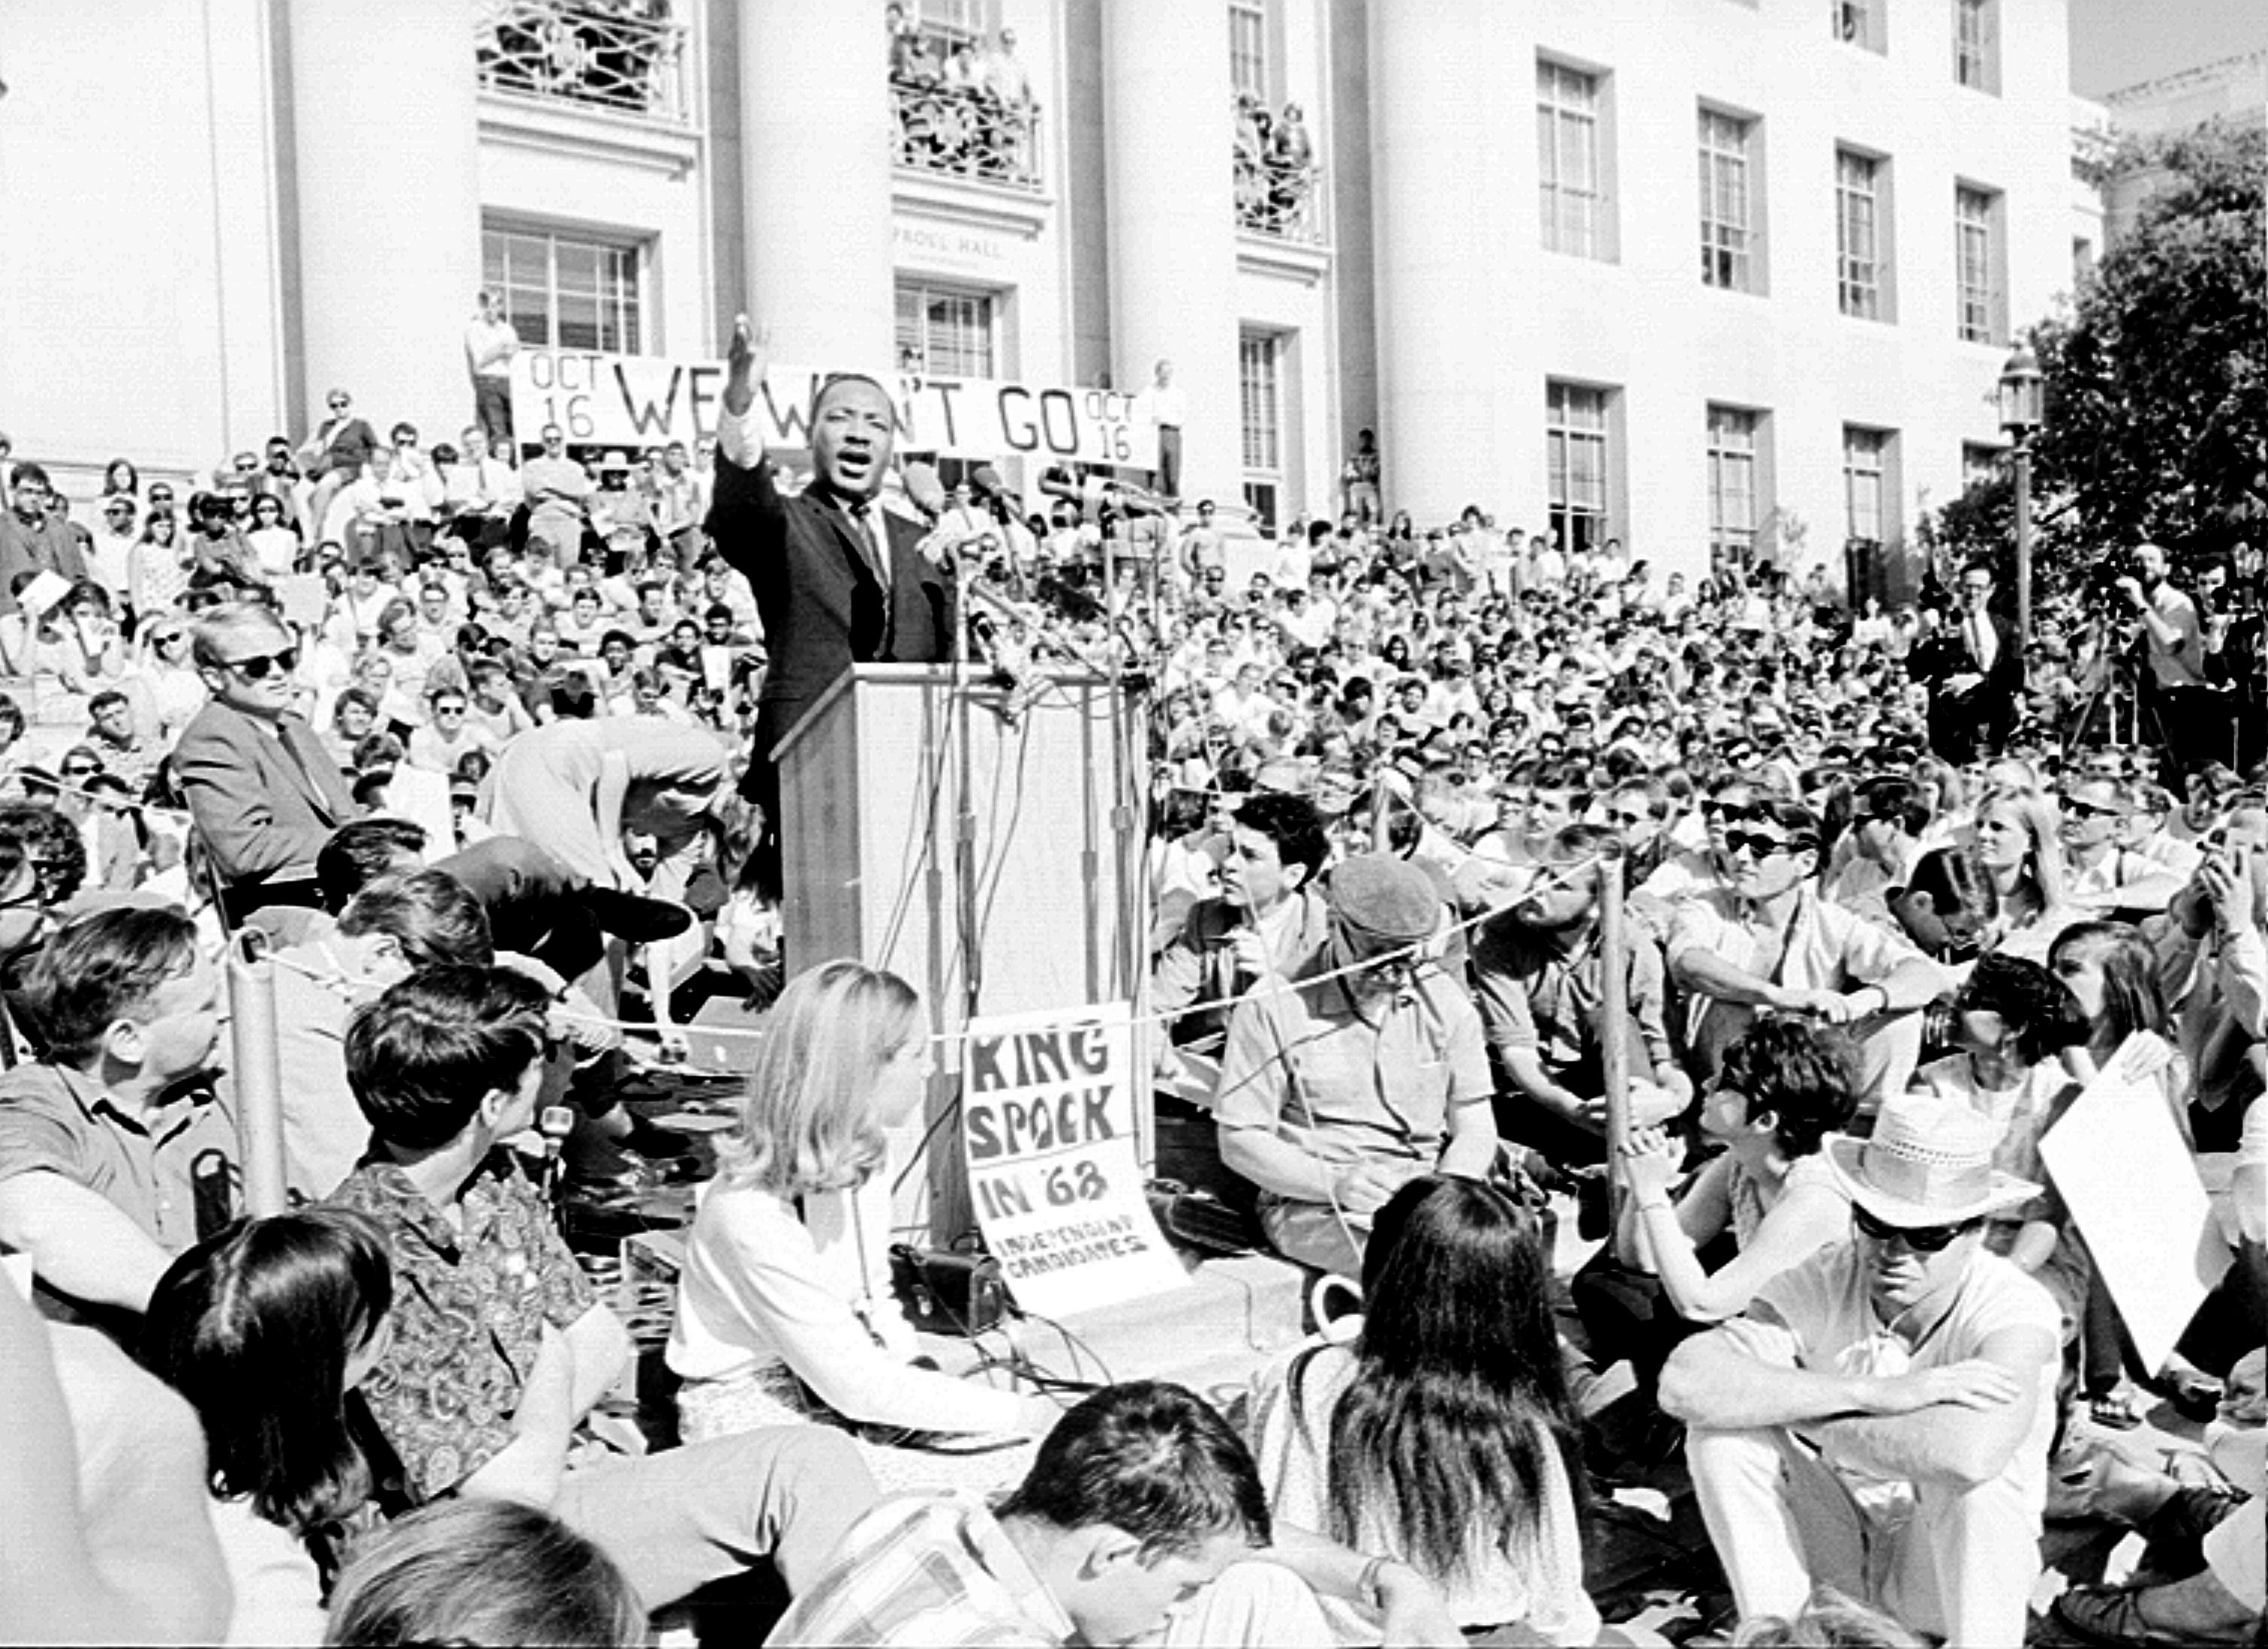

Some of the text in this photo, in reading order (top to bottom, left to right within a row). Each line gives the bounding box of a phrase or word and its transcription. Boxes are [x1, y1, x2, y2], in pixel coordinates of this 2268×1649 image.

[959, 236, 1002, 259] HALL
[530, 353, 603, 390] OCT
[544, 394, 594, 438] 16
[613, 363, 1079, 456] WE WN'T GO
[1086, 390, 1137, 423] OCT
[1099, 424, 1131, 461] 16
[971, 1019, 1109, 1093] KING
[967, 1085, 1115, 1160] SPOCK
[978, 1160, 1109, 1220] IN '68
[1007, 1235, 1149, 1278] CANDIDATES
